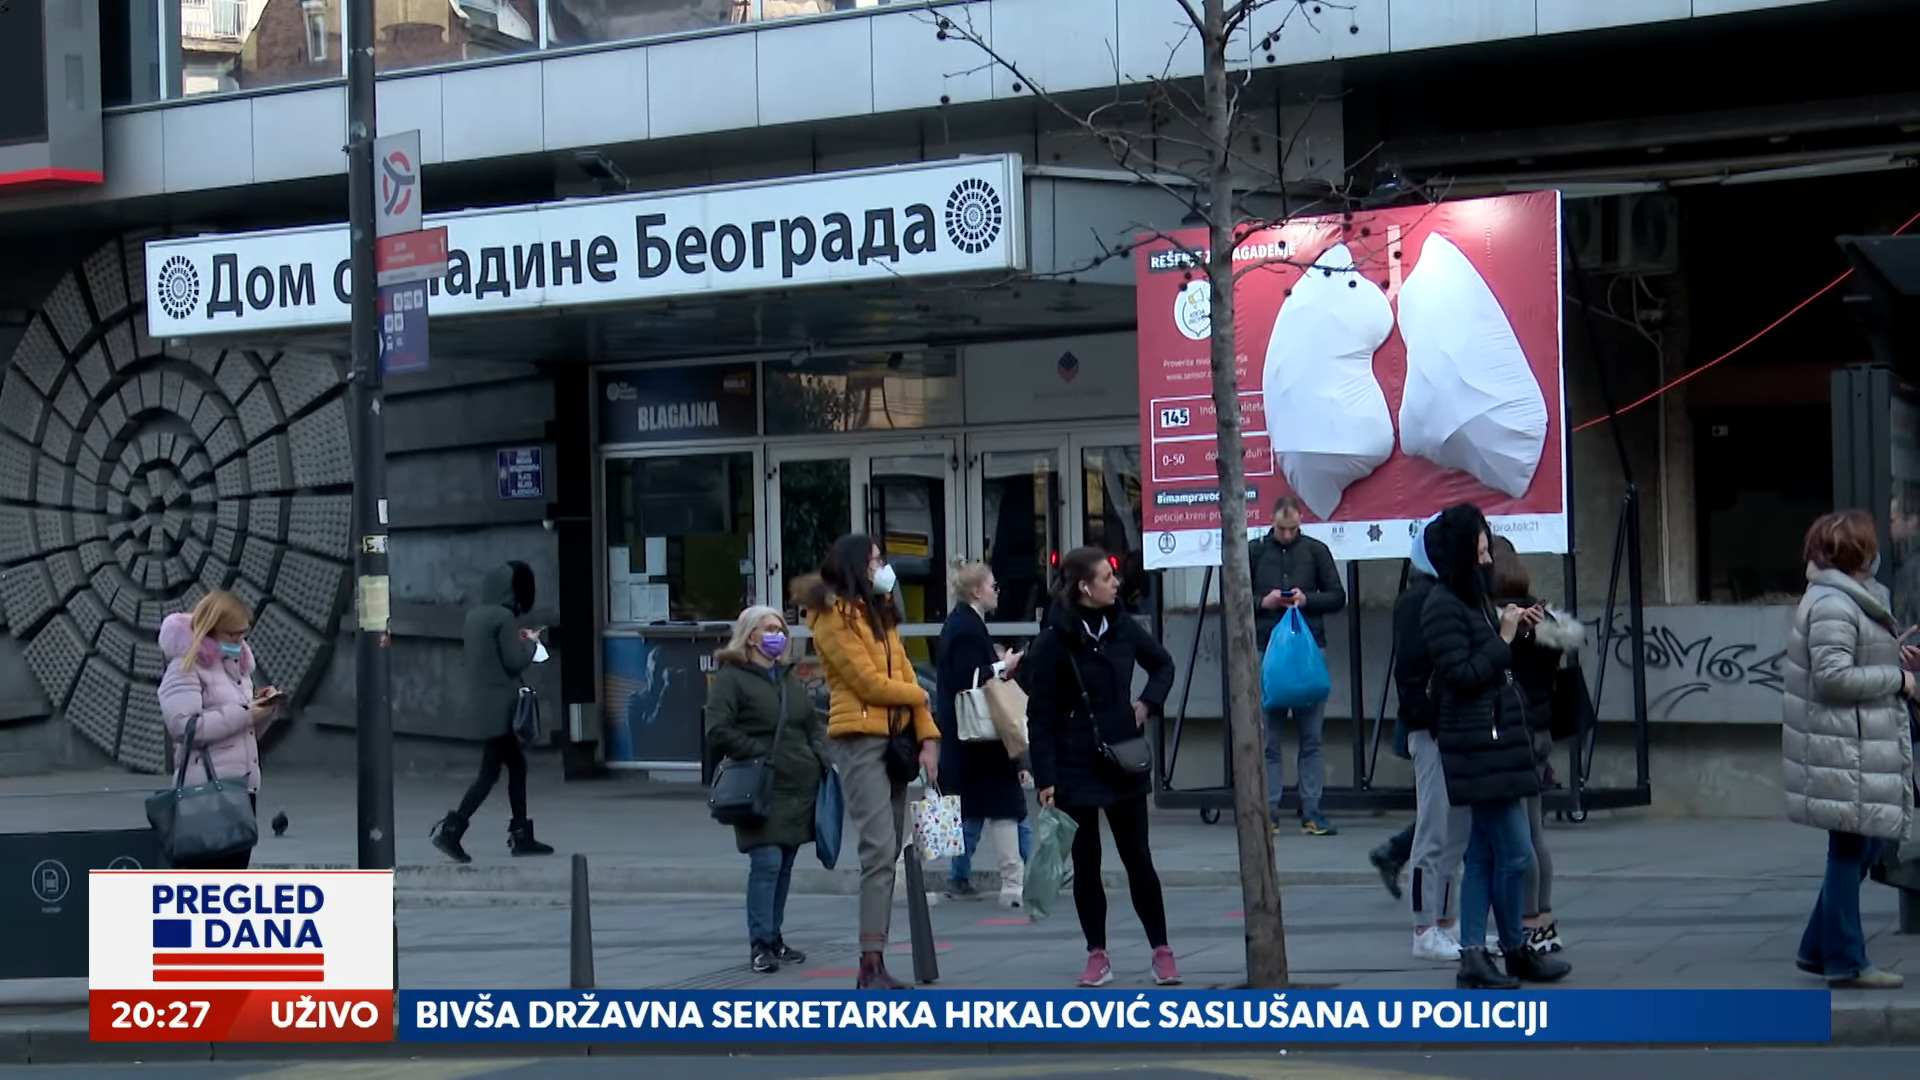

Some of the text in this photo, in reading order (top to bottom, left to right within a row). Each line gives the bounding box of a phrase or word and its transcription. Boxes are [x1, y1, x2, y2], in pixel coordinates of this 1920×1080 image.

[206, 253, 316, 319] Дом
[635, 202, 937, 279] Београда
[637, 401, 719, 431] BLAGAJNA
[1163, 411, 1188, 426] 145
[1162, 454, 1185, 466] 0-50
